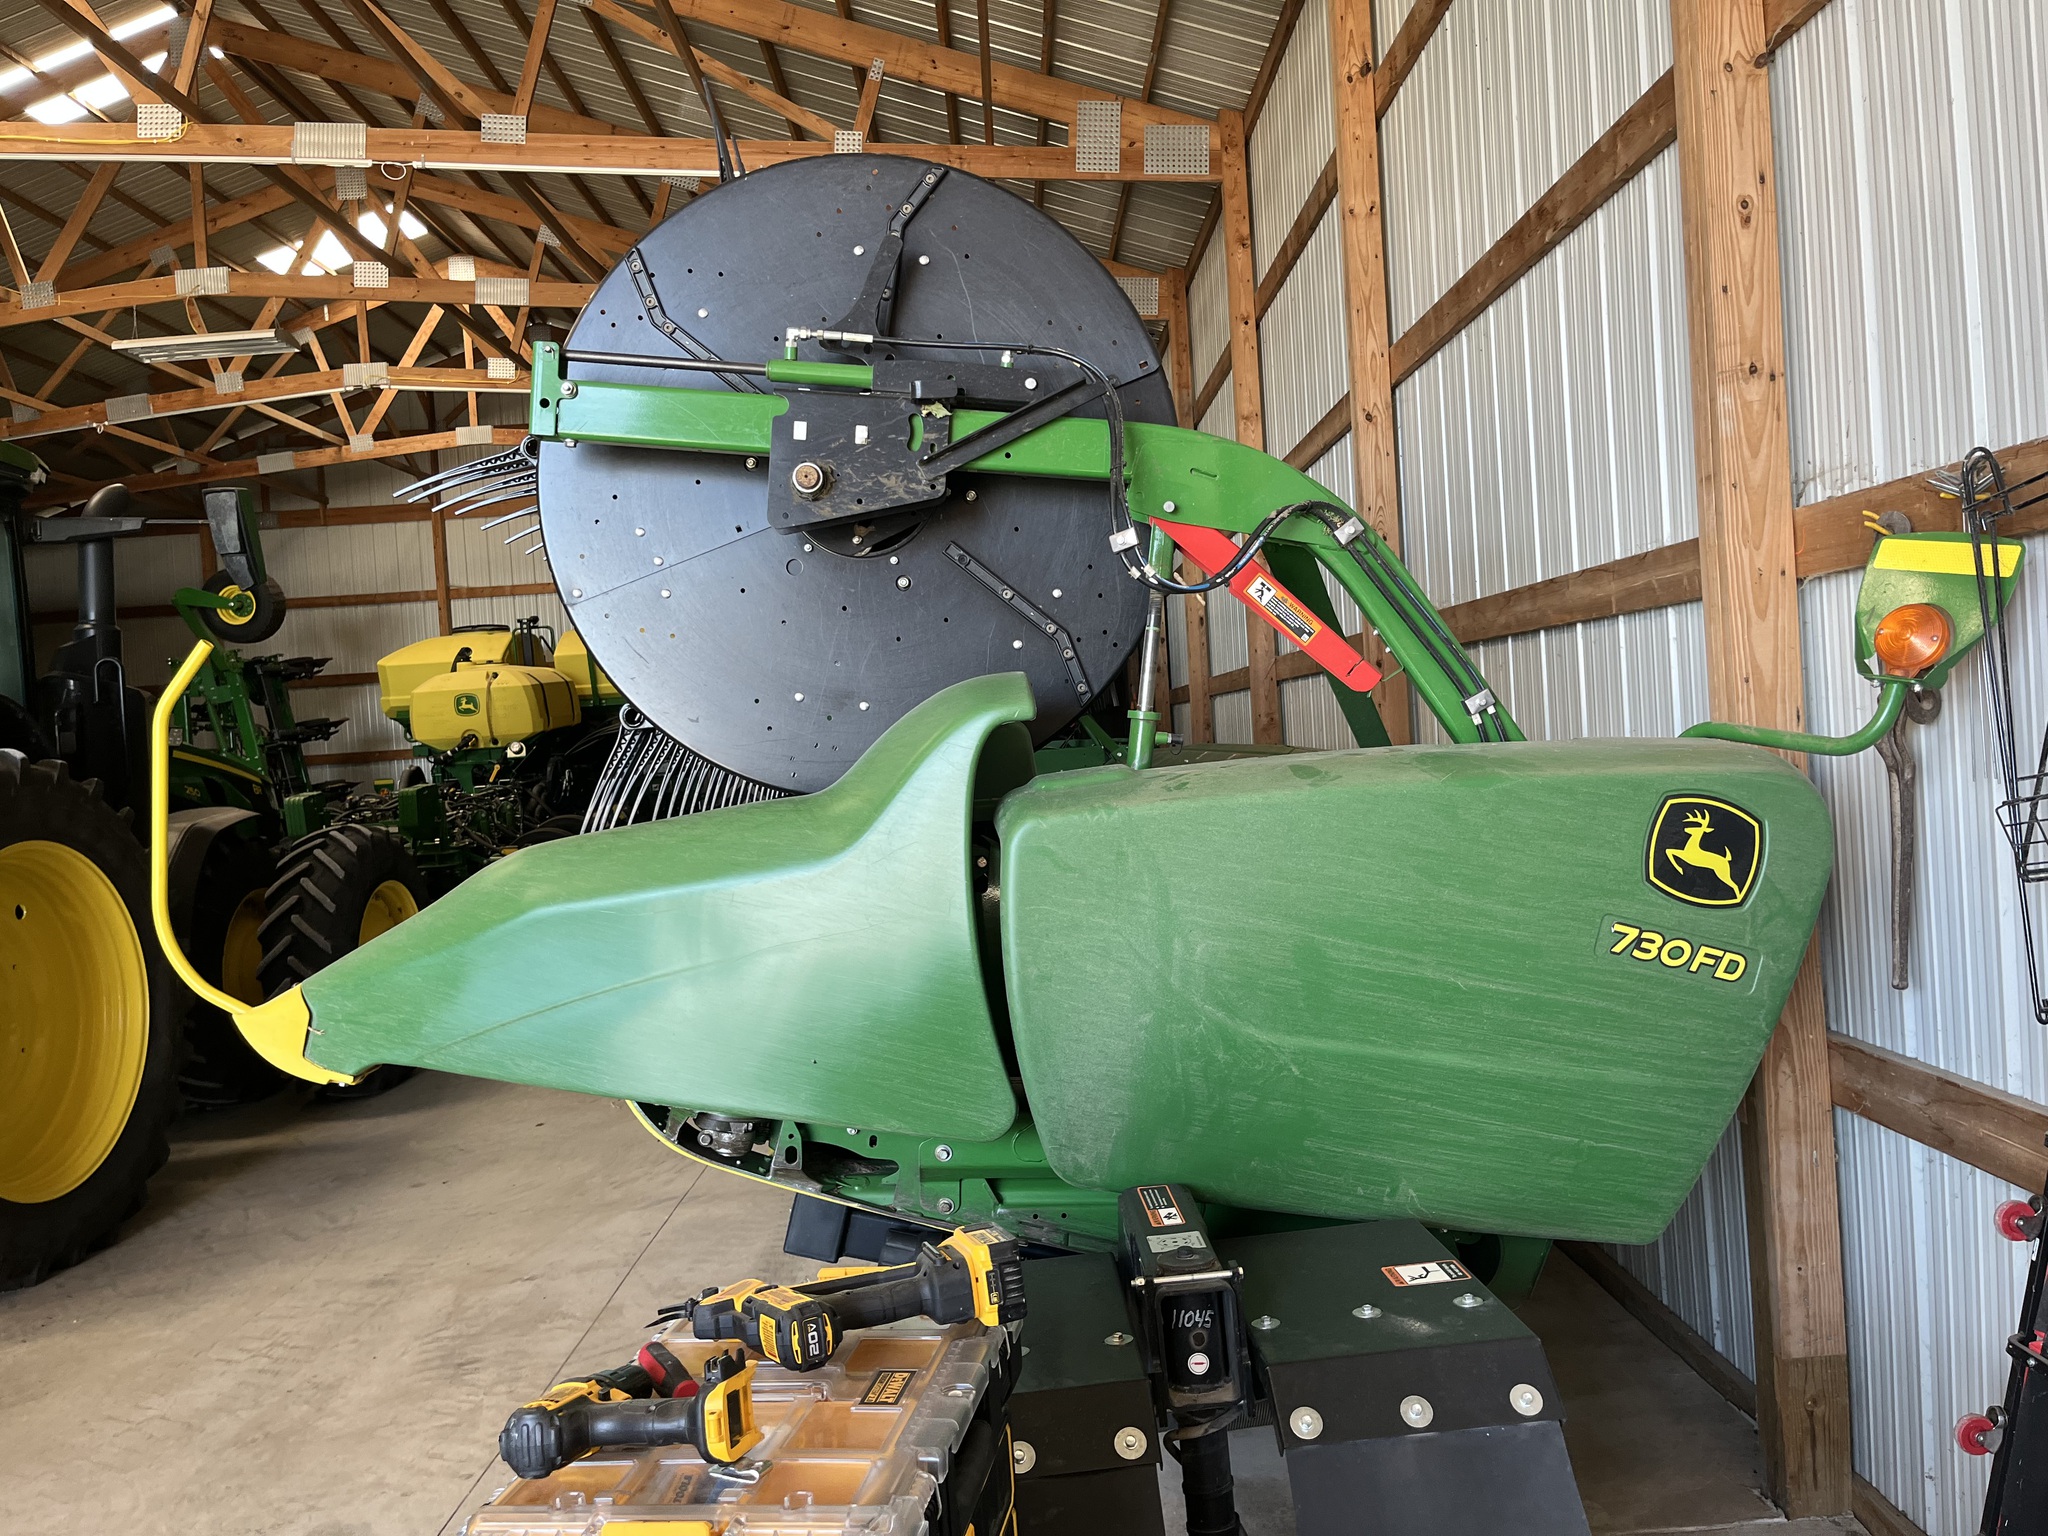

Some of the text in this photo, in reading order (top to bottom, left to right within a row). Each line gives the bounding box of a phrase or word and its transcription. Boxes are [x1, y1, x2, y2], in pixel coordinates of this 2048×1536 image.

[1289, 601, 1314, 625] WARNING
[1610, 921, 1748, 982] 730FD
[1171, 1309, 1214, 1329] 11045
